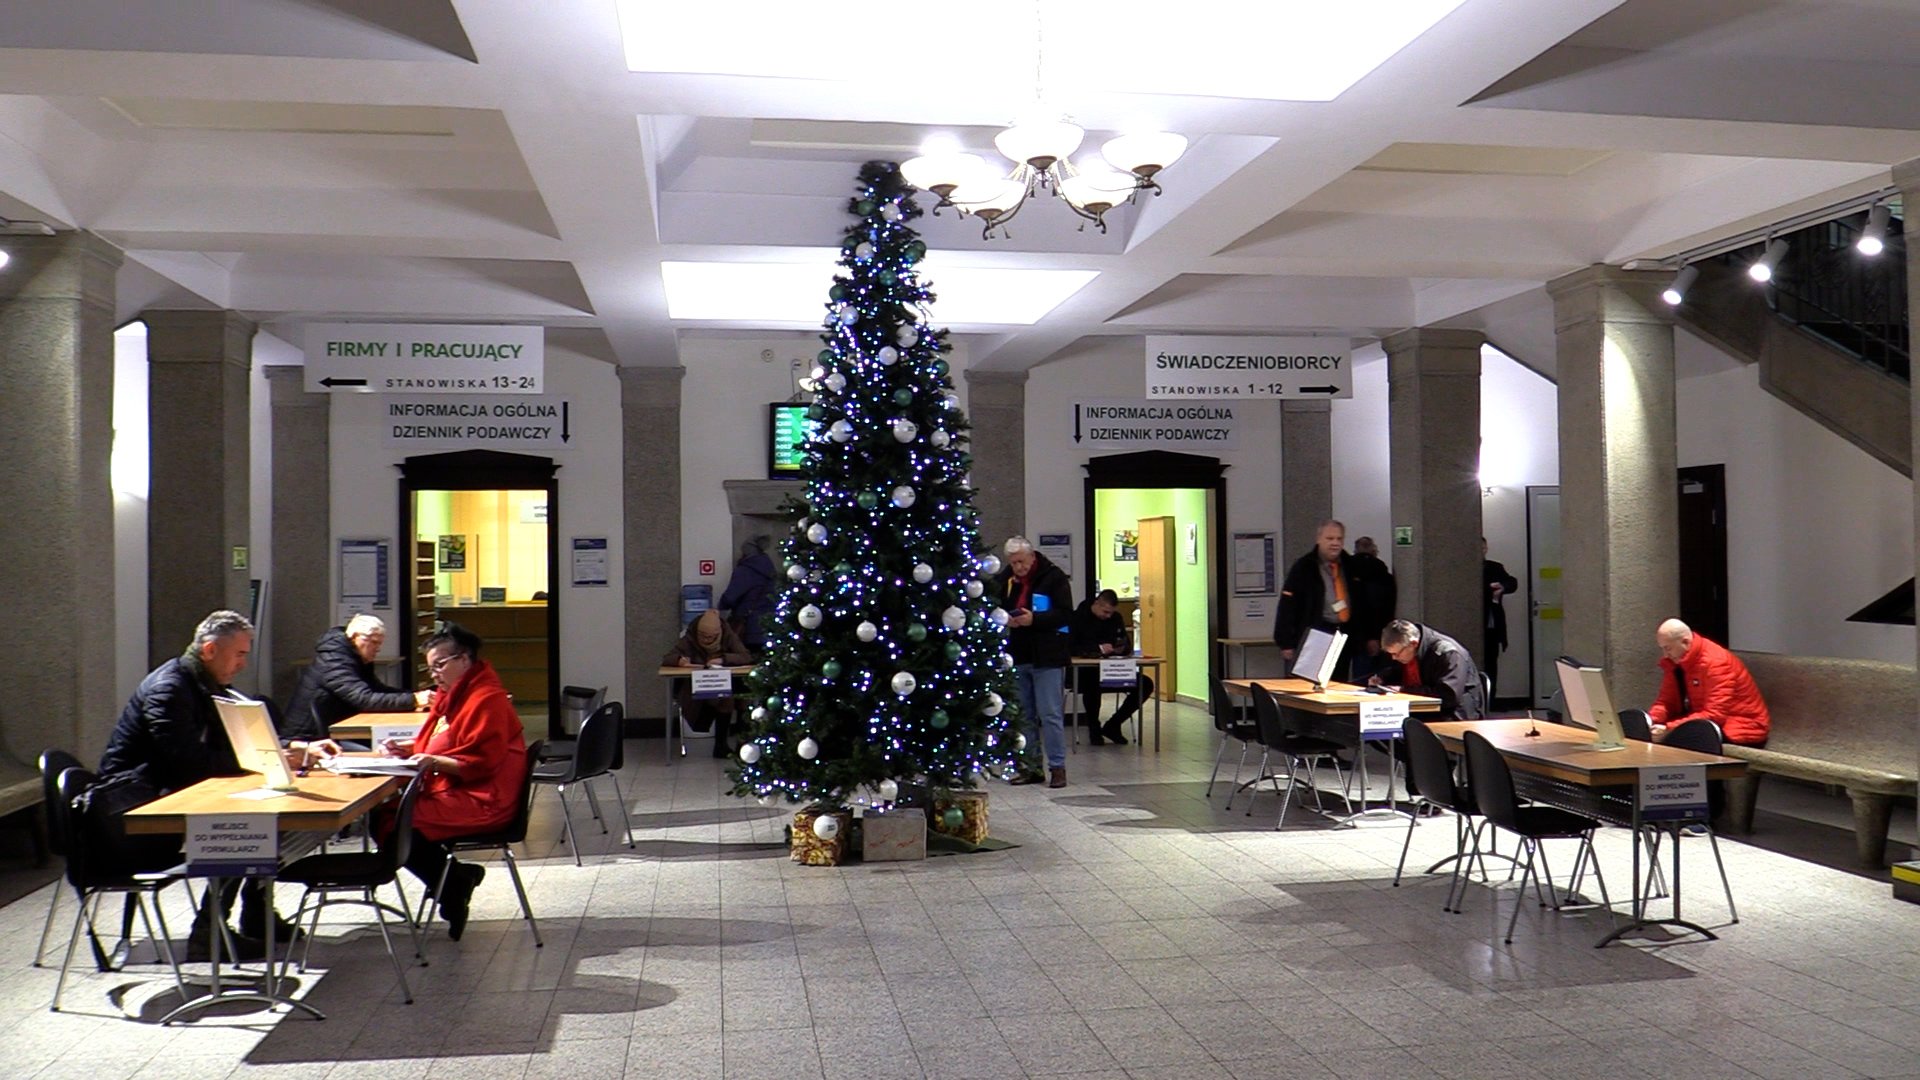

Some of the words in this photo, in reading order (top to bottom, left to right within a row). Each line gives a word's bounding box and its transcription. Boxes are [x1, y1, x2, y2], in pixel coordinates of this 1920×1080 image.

[326, 341, 388, 357] FIRMY
[396, 343, 401, 357] I
[411, 342, 523, 361] PRACUJĄCY
[1156, 352, 1342, 369] ŚWIADCZENIOBIORCY
[386, 379, 487, 388] STANOWISKA
[492, 376, 535, 389] 13-24
[1151, 386, 1240, 394] STANOWISKA
[389, 404, 488, 417] INFORMACJA
[493, 401, 558, 417] OGÓLNA
[1086, 407, 1174, 419] INFORMACJA
[1176, 405, 1233, 419] OGÓLNA
[393, 426, 463, 438] DZIENNIK
[467, 426, 551, 439] PODAWCZY
[1090, 429, 1152, 440] DZIENNIK
[1156, 429, 1230, 440] PODAWCZY
